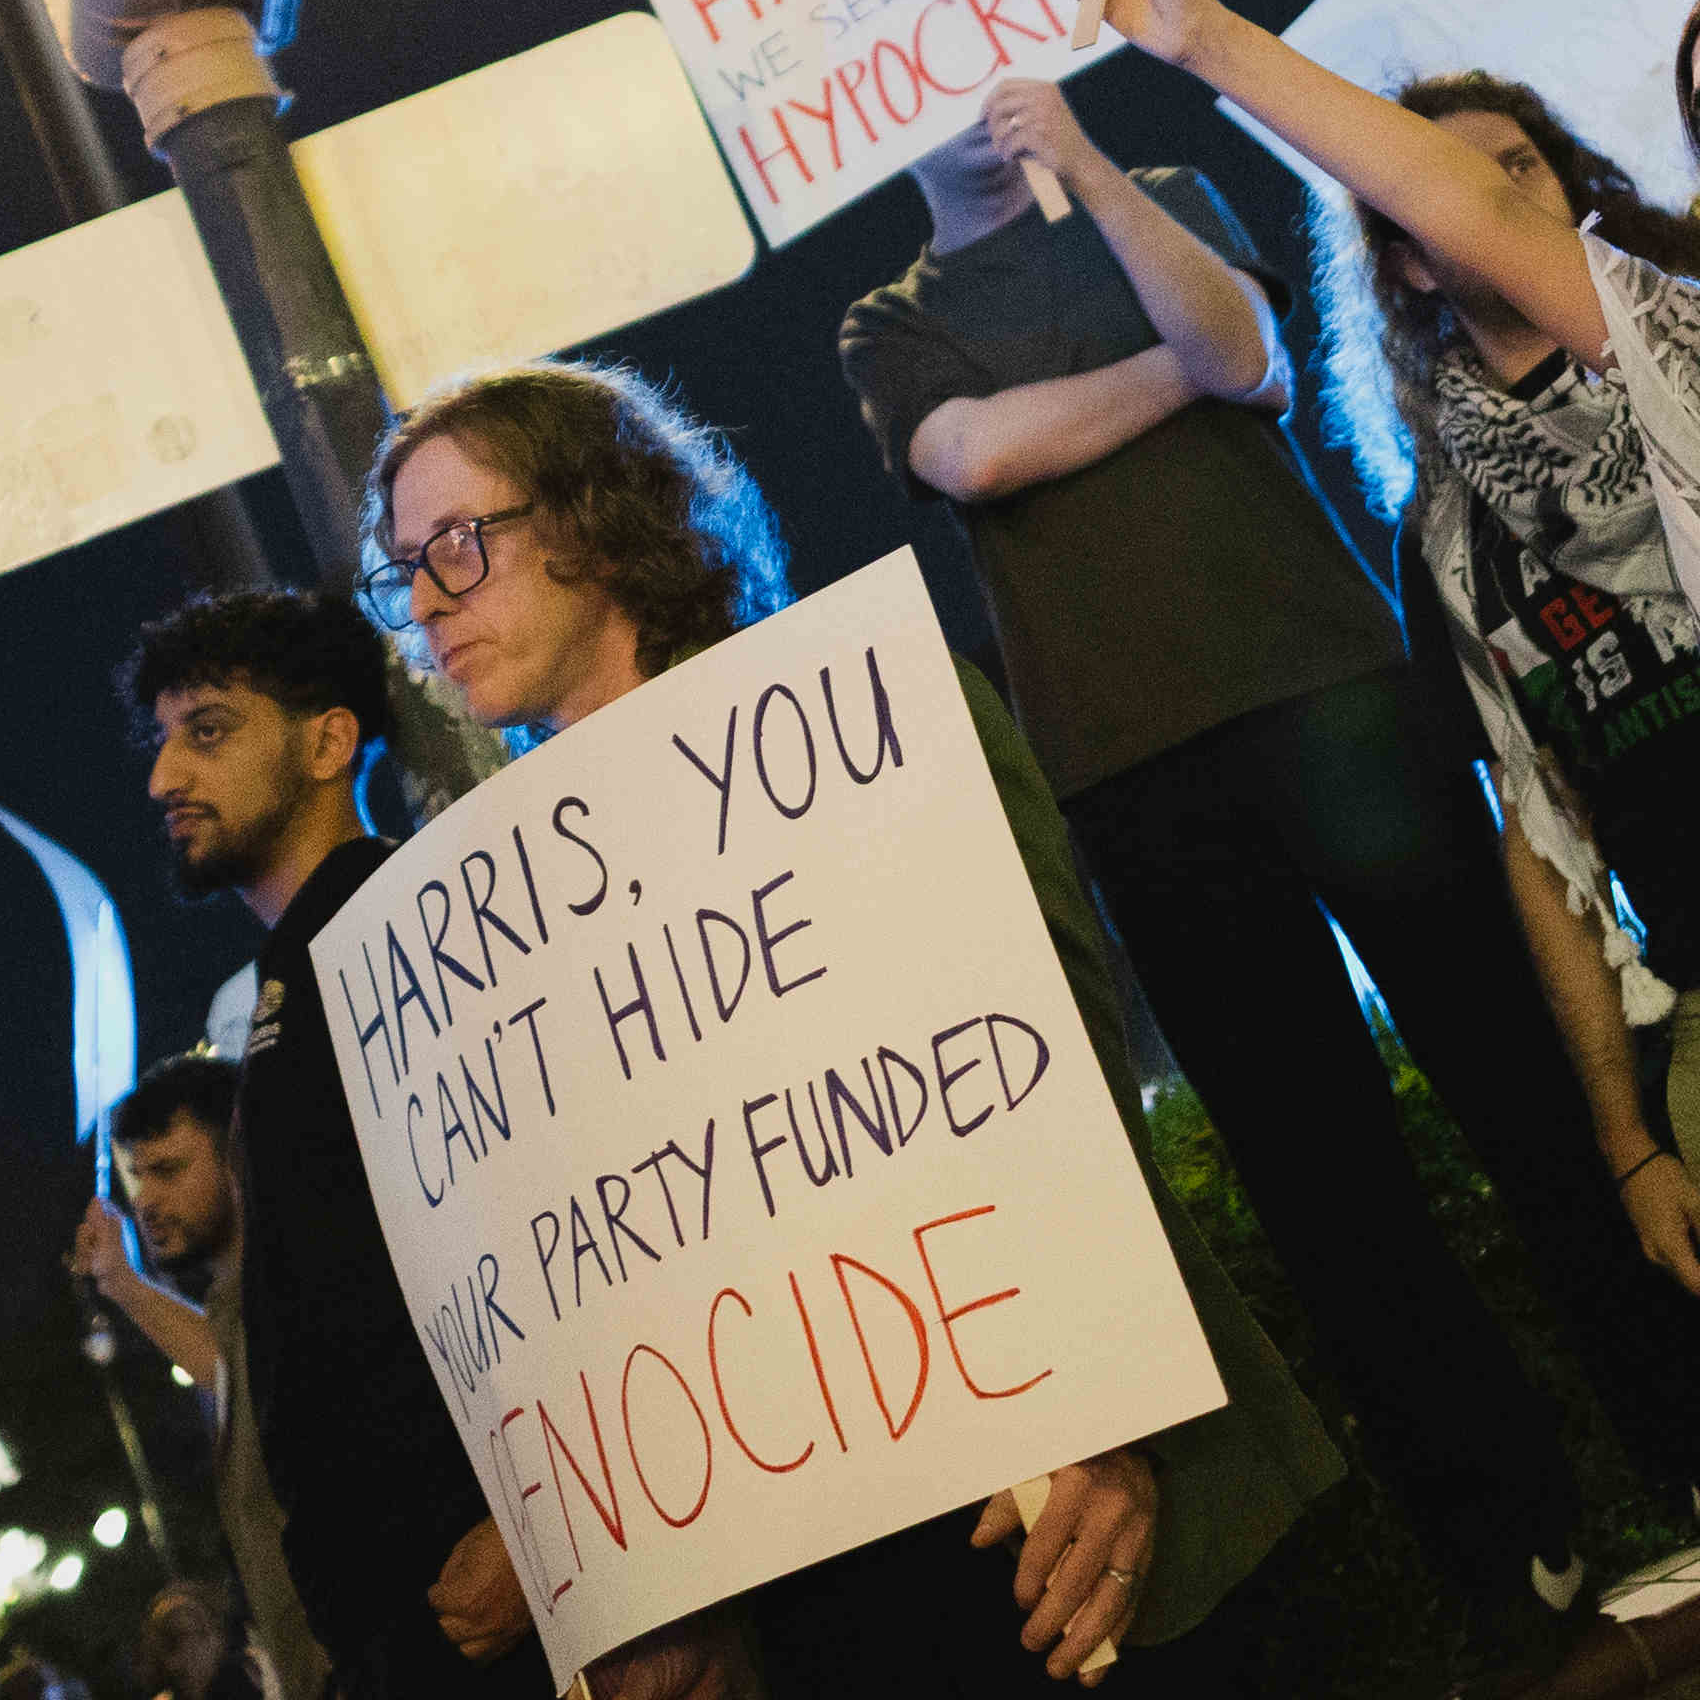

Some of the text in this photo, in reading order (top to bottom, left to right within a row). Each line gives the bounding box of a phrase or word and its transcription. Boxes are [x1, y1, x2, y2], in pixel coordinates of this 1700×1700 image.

[717, 30, 803, 101] WE
[336, 645, 905, 1120] HARRIS, YOU
[407, 870, 828, 1209] CAN'T HIDE
[425, 1011, 1052, 1424] YOUR PARTY FUNDED
[490, 1204, 1055, 1616] GENOCIDE
